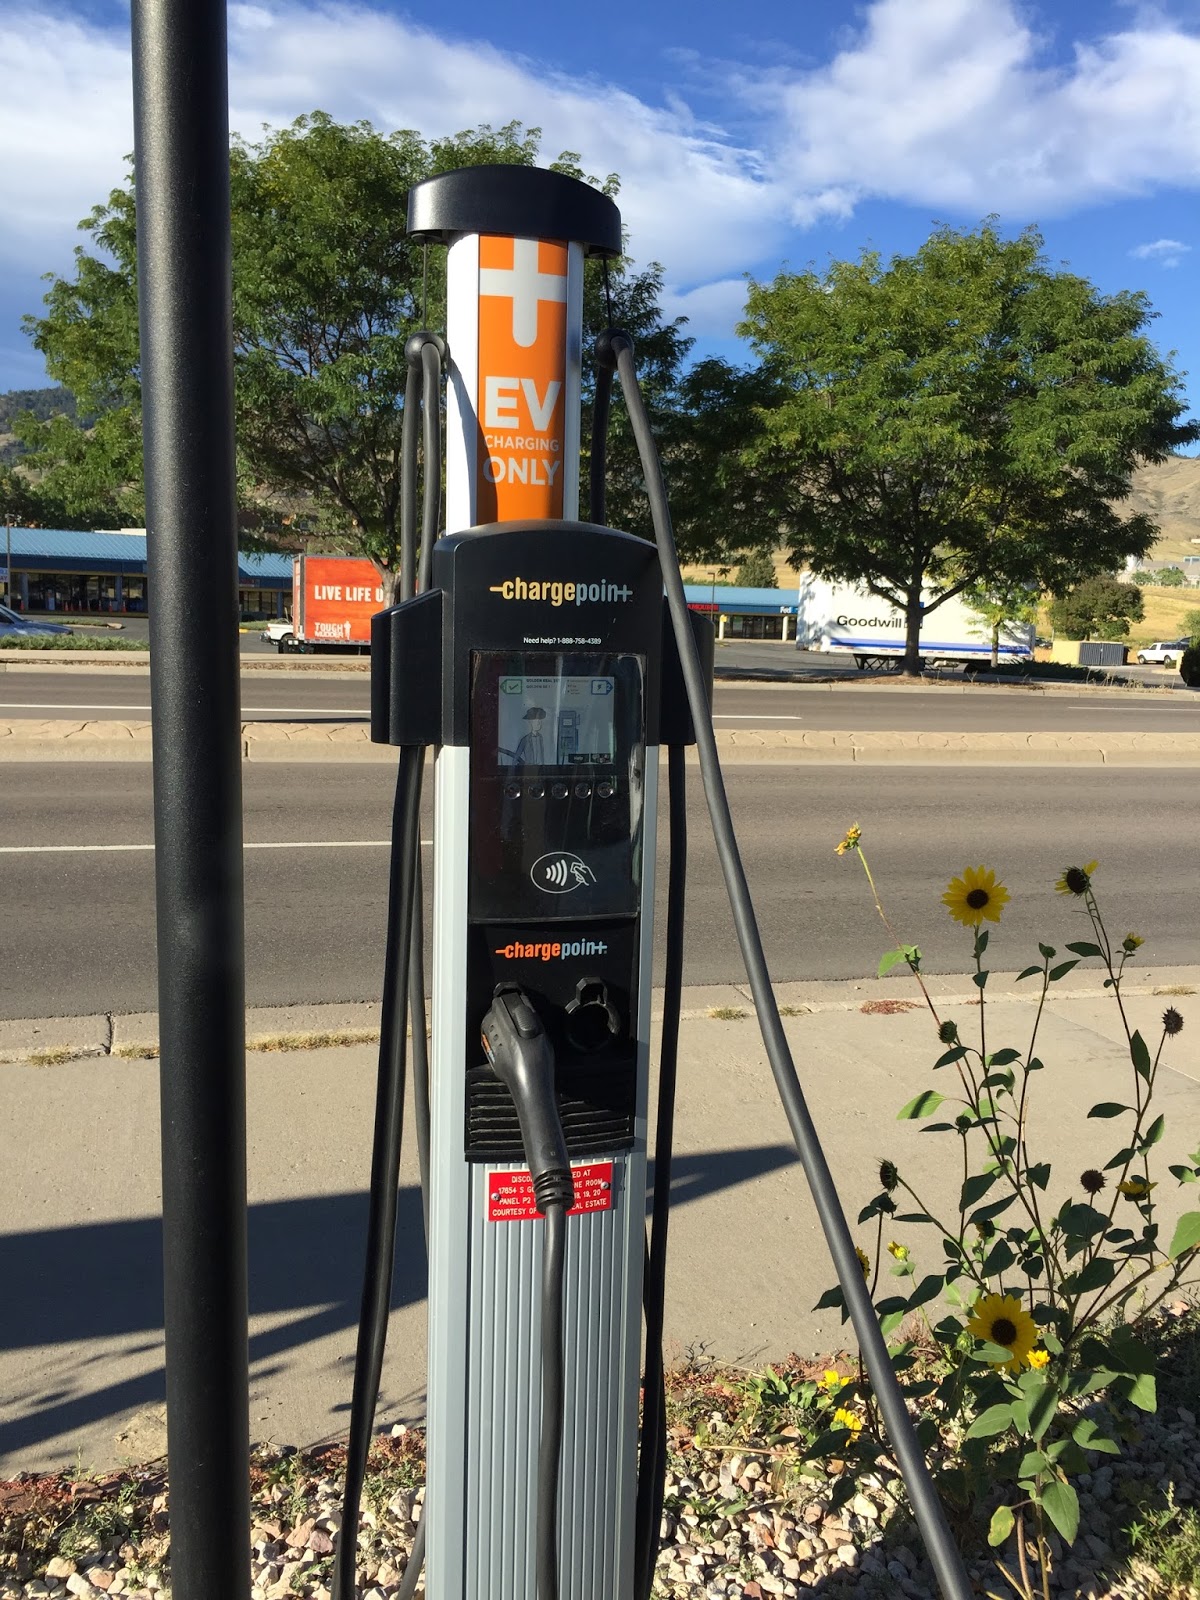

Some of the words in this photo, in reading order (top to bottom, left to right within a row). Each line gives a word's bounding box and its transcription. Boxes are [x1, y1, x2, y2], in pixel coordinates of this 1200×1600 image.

[485, 376, 561, 431] EV
[485, 434, 559, 452] CHARGING
[483, 456, 560, 486] ONLY
[315, 585, 341, 600] LIVE
[346, 586, 371, 602] LIFE
[376, 588, 384, 602] U
[315, 622, 343, 632] TOUGH
[837, 615, 902, 628] Goodwill
[540, 637, 556, 645] help?
[511, 1175, 533, 1184] DISCO
[571, 1170, 582, 1179] ED
[583, 1169, 592, 1177] AT
[574, 1181, 583, 1189] NE
[585, 1178, 603, 1187] ROOM
[593, 1189, 602, 1197] 20
[492, 1208, 526, 1216] COURTESY
[585, 1198, 607, 1208] ESTATE
